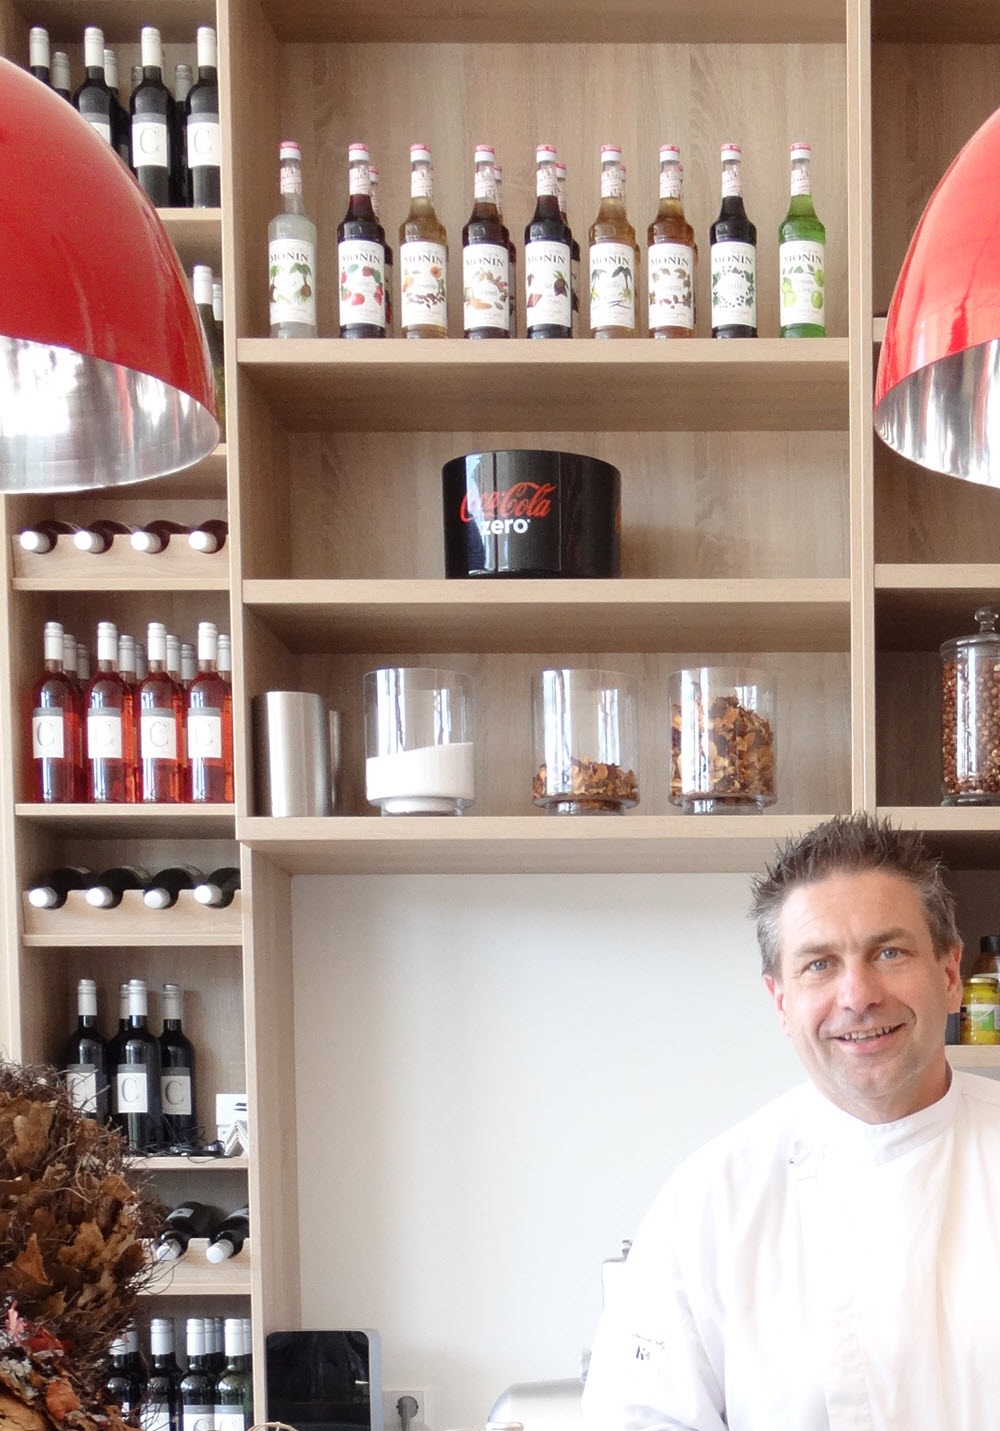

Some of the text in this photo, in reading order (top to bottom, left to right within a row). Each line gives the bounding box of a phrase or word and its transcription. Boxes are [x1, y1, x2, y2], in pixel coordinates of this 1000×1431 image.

[270, 252, 309, 262] MONIN
[342, 253, 381, 264] MONIN
[404, 254, 443, 265] MONIN
[466, 257, 504, 267] MONIN
[527, 254, 566, 265] MONIN
[592, 256, 630, 266] MONIN
[650, 256, 689, 267] MONIN
[714, 255, 752, 265] MONIN
[784, 253, 822, 264] MONIN
[480, 518, 529, 536] zero
